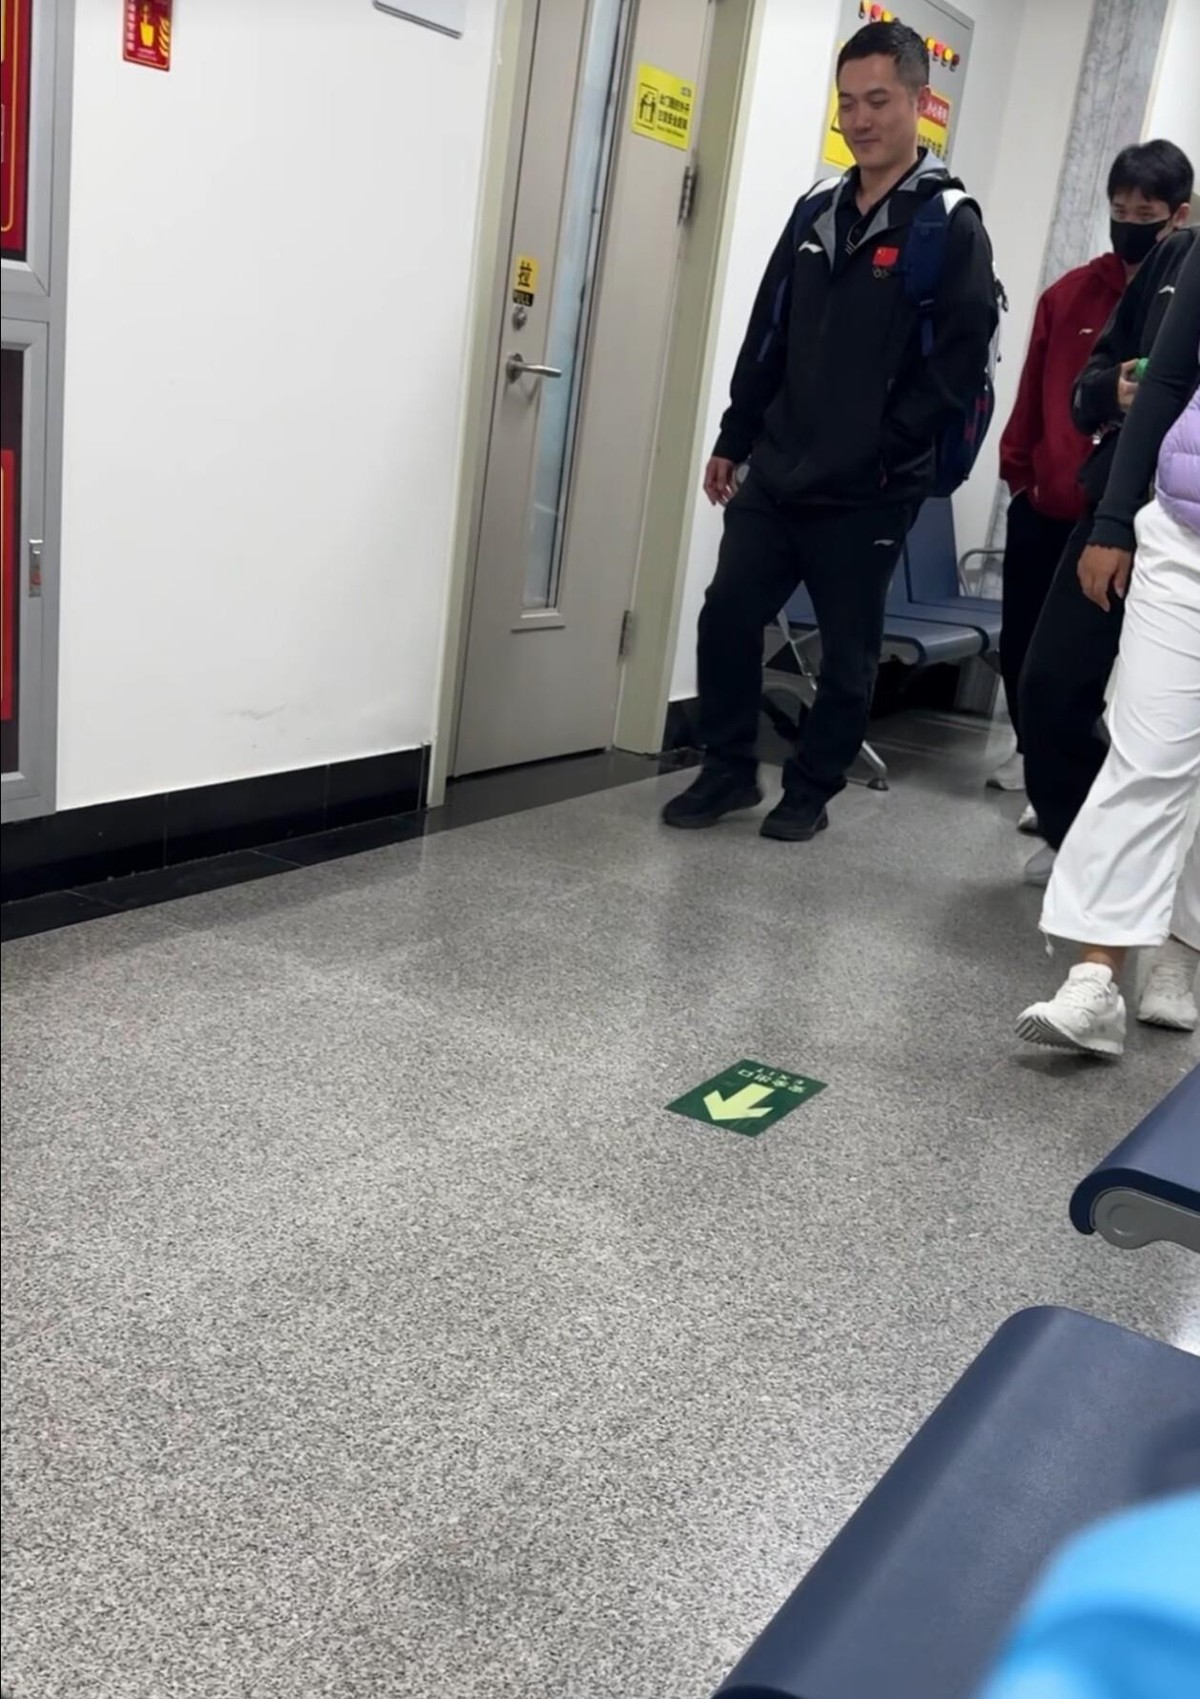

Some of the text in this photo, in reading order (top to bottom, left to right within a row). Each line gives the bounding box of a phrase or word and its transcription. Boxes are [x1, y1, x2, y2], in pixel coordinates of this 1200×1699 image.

[517, 260, 532, 287] 拉
[738, 1069, 806, 1093] 安全出口
